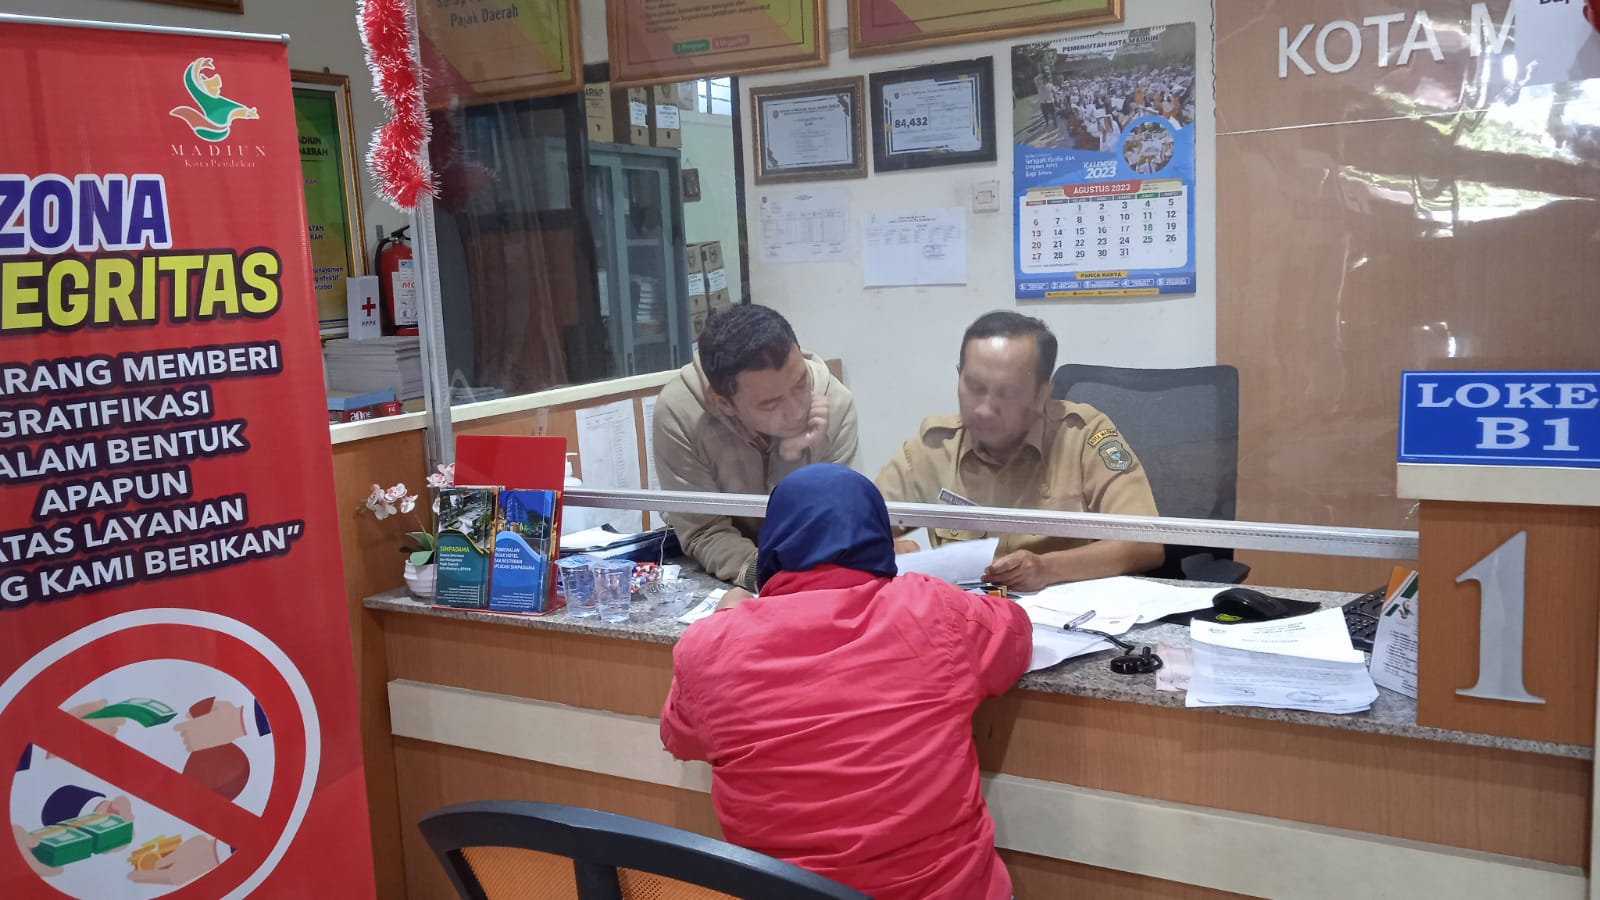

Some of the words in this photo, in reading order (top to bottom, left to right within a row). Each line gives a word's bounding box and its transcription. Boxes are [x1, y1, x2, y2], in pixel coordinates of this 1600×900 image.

[450, 13, 478, 28] Pajak
[482, 3, 518, 22] Daerah
[1278, 10, 1444, 78] KOTA
[895, 117, 928, 129] 84,432
[171, 144, 266, 157] MADIUN
[1073, 185, 1110, 194] AGUSTUS
[1111, 183, 1131, 192] 2023
[1084, 167, 1117, 180] 2023
[0, 176, 170, 251] ZONA
[1166, 210, 1176, 218] 12
[1166, 222, 1177, 230] 19
[1053, 240, 1062, 248] 21
[1075, 239, 1085, 247] 22
[1143, 236, 1153, 244] 25
[1165, 234, 1177, 242] 26
[1075, 250, 1085, 258] 29
[1097, 249, 1107, 257] 30
[1120, 248, 1129, 256] 31
[2, 252, 278, 329] EGRITAS
[123, 346, 278, 382] MEMBERI
[1417, 382, 1599, 409] LOKE
[0, 390, 209, 438] GRATIFIKASI
[107, 424, 244, 464] BENTUK
[1476, 417, 1580, 451] B1
[40, 471, 188, 516] APAPUN
[84, 498, 243, 548] LAYANAN
[40, 555, 134, 596] KAMI
[1456, 530, 1546, 704] 1
